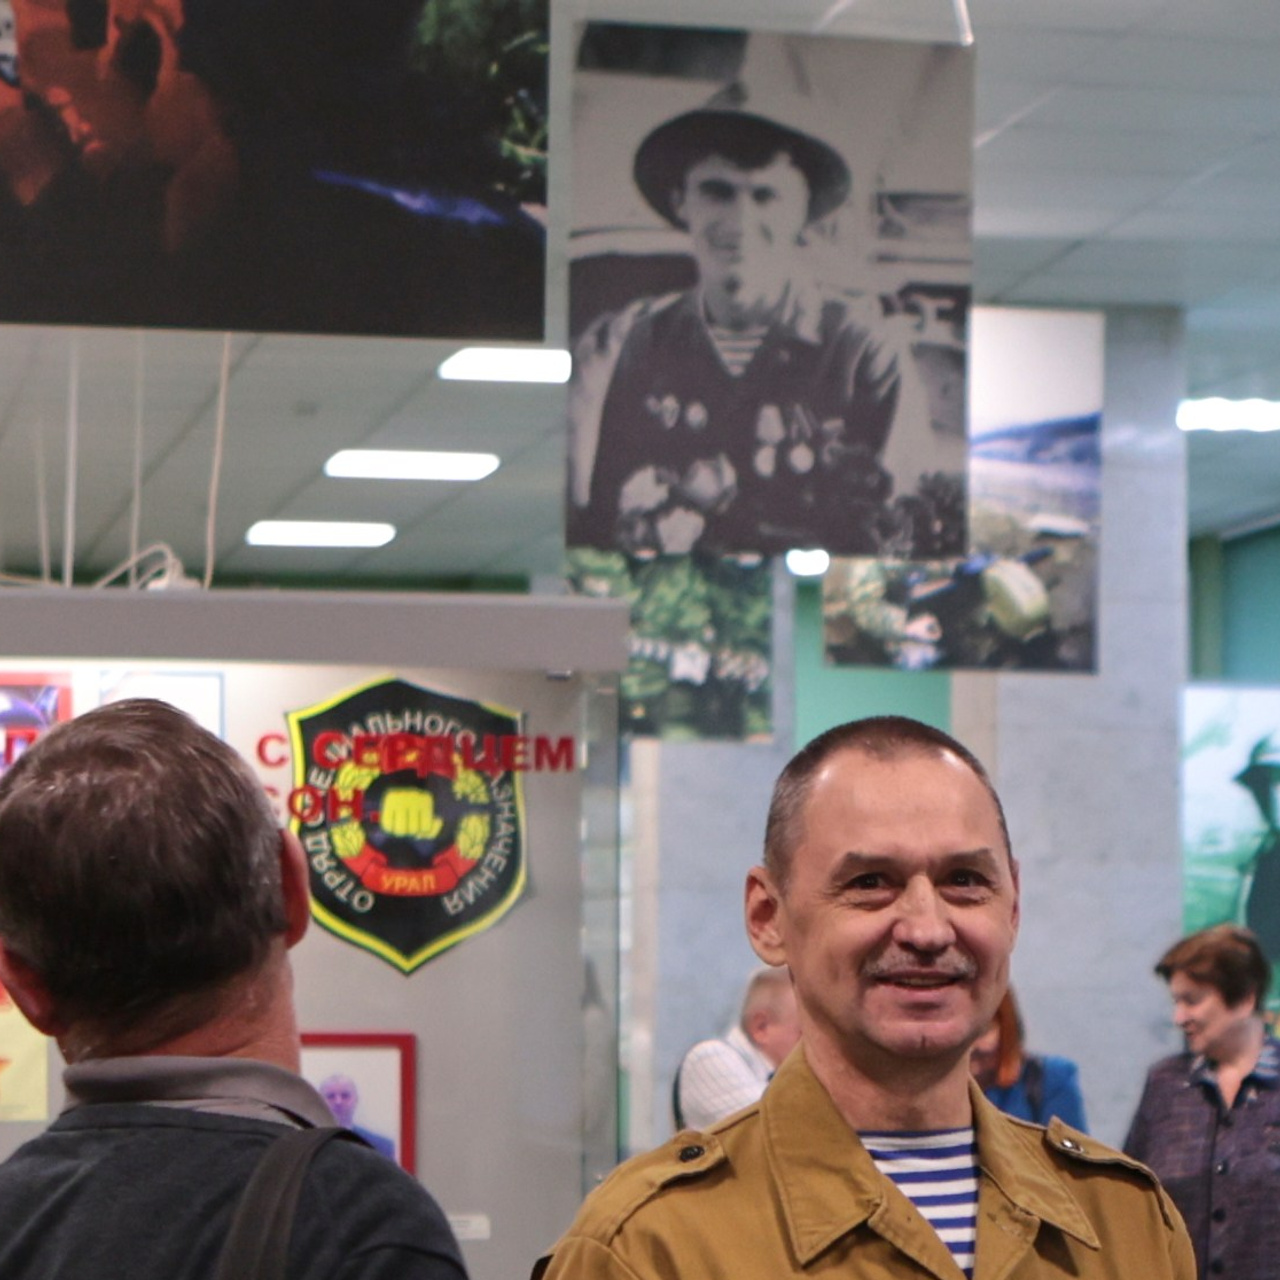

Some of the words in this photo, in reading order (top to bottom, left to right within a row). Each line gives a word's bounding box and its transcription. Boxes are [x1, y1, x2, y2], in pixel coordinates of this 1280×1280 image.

[257, 733, 290, 768] С
[312, 730, 576, 779] СЕРДЦЕМ
[304, 829, 375, 912] ОТРЯД
[380, 873, 436, 893] УРАЛ
